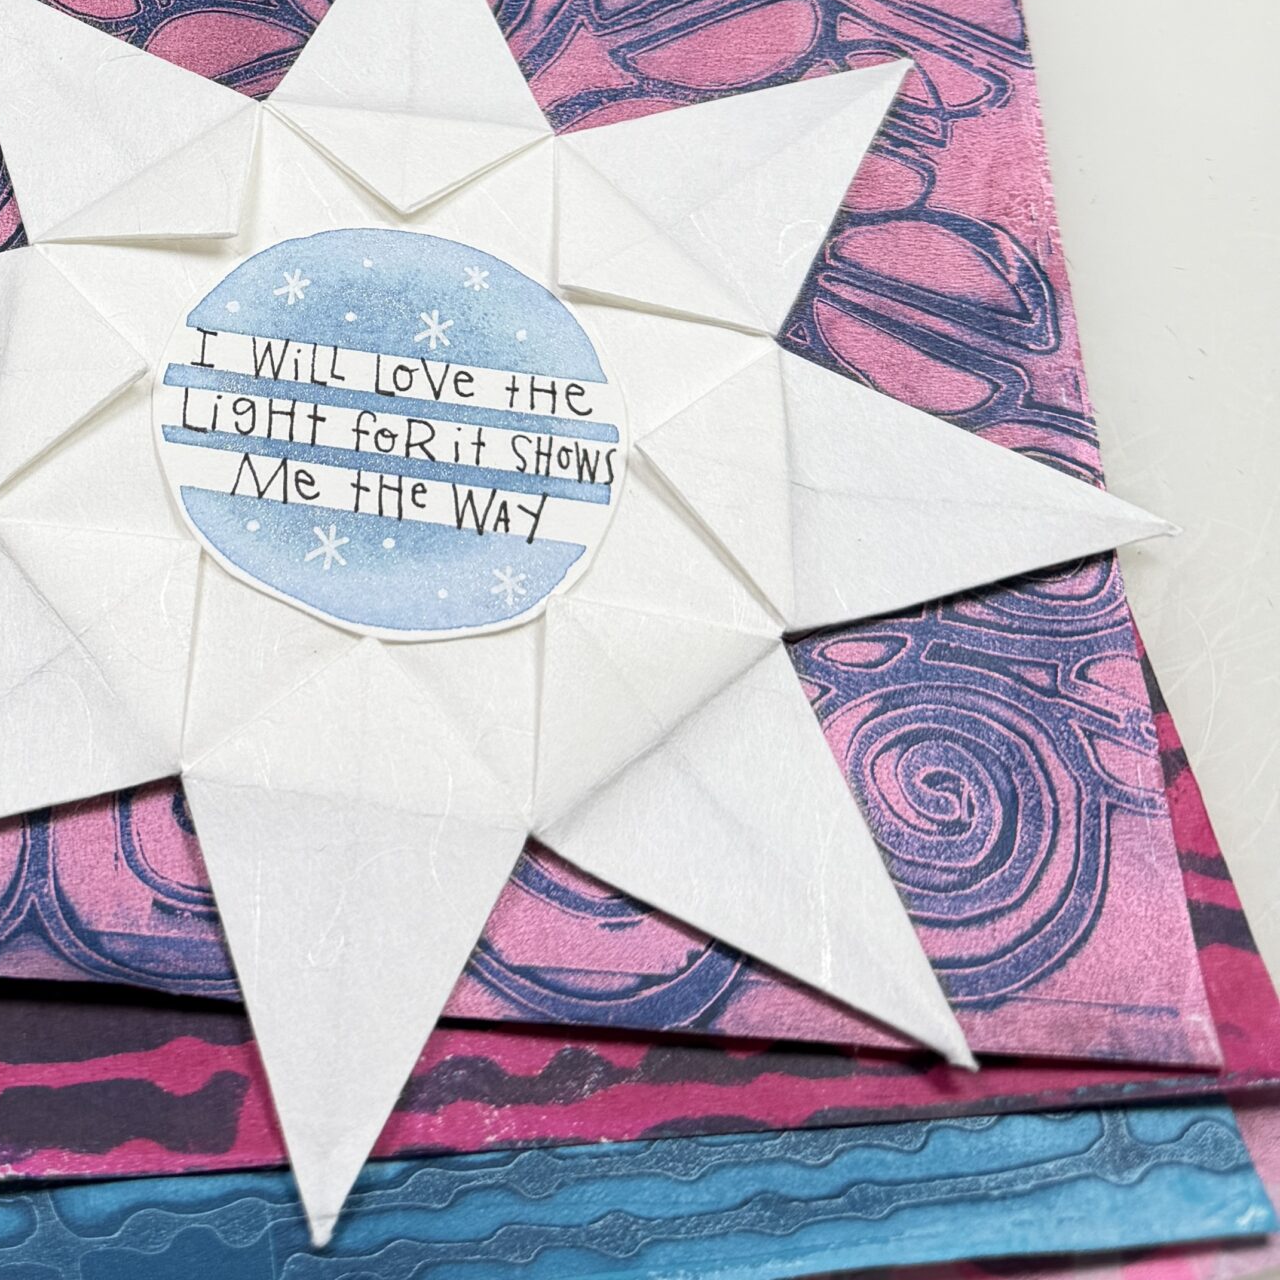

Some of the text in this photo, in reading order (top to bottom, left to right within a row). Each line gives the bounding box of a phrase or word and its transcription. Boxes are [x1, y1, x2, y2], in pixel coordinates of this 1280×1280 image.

[190, 327, 218, 368] I
[454, 427, 486, 466] it
[230, 452, 320, 505] Me
[452, 483, 549, 545] WAY
